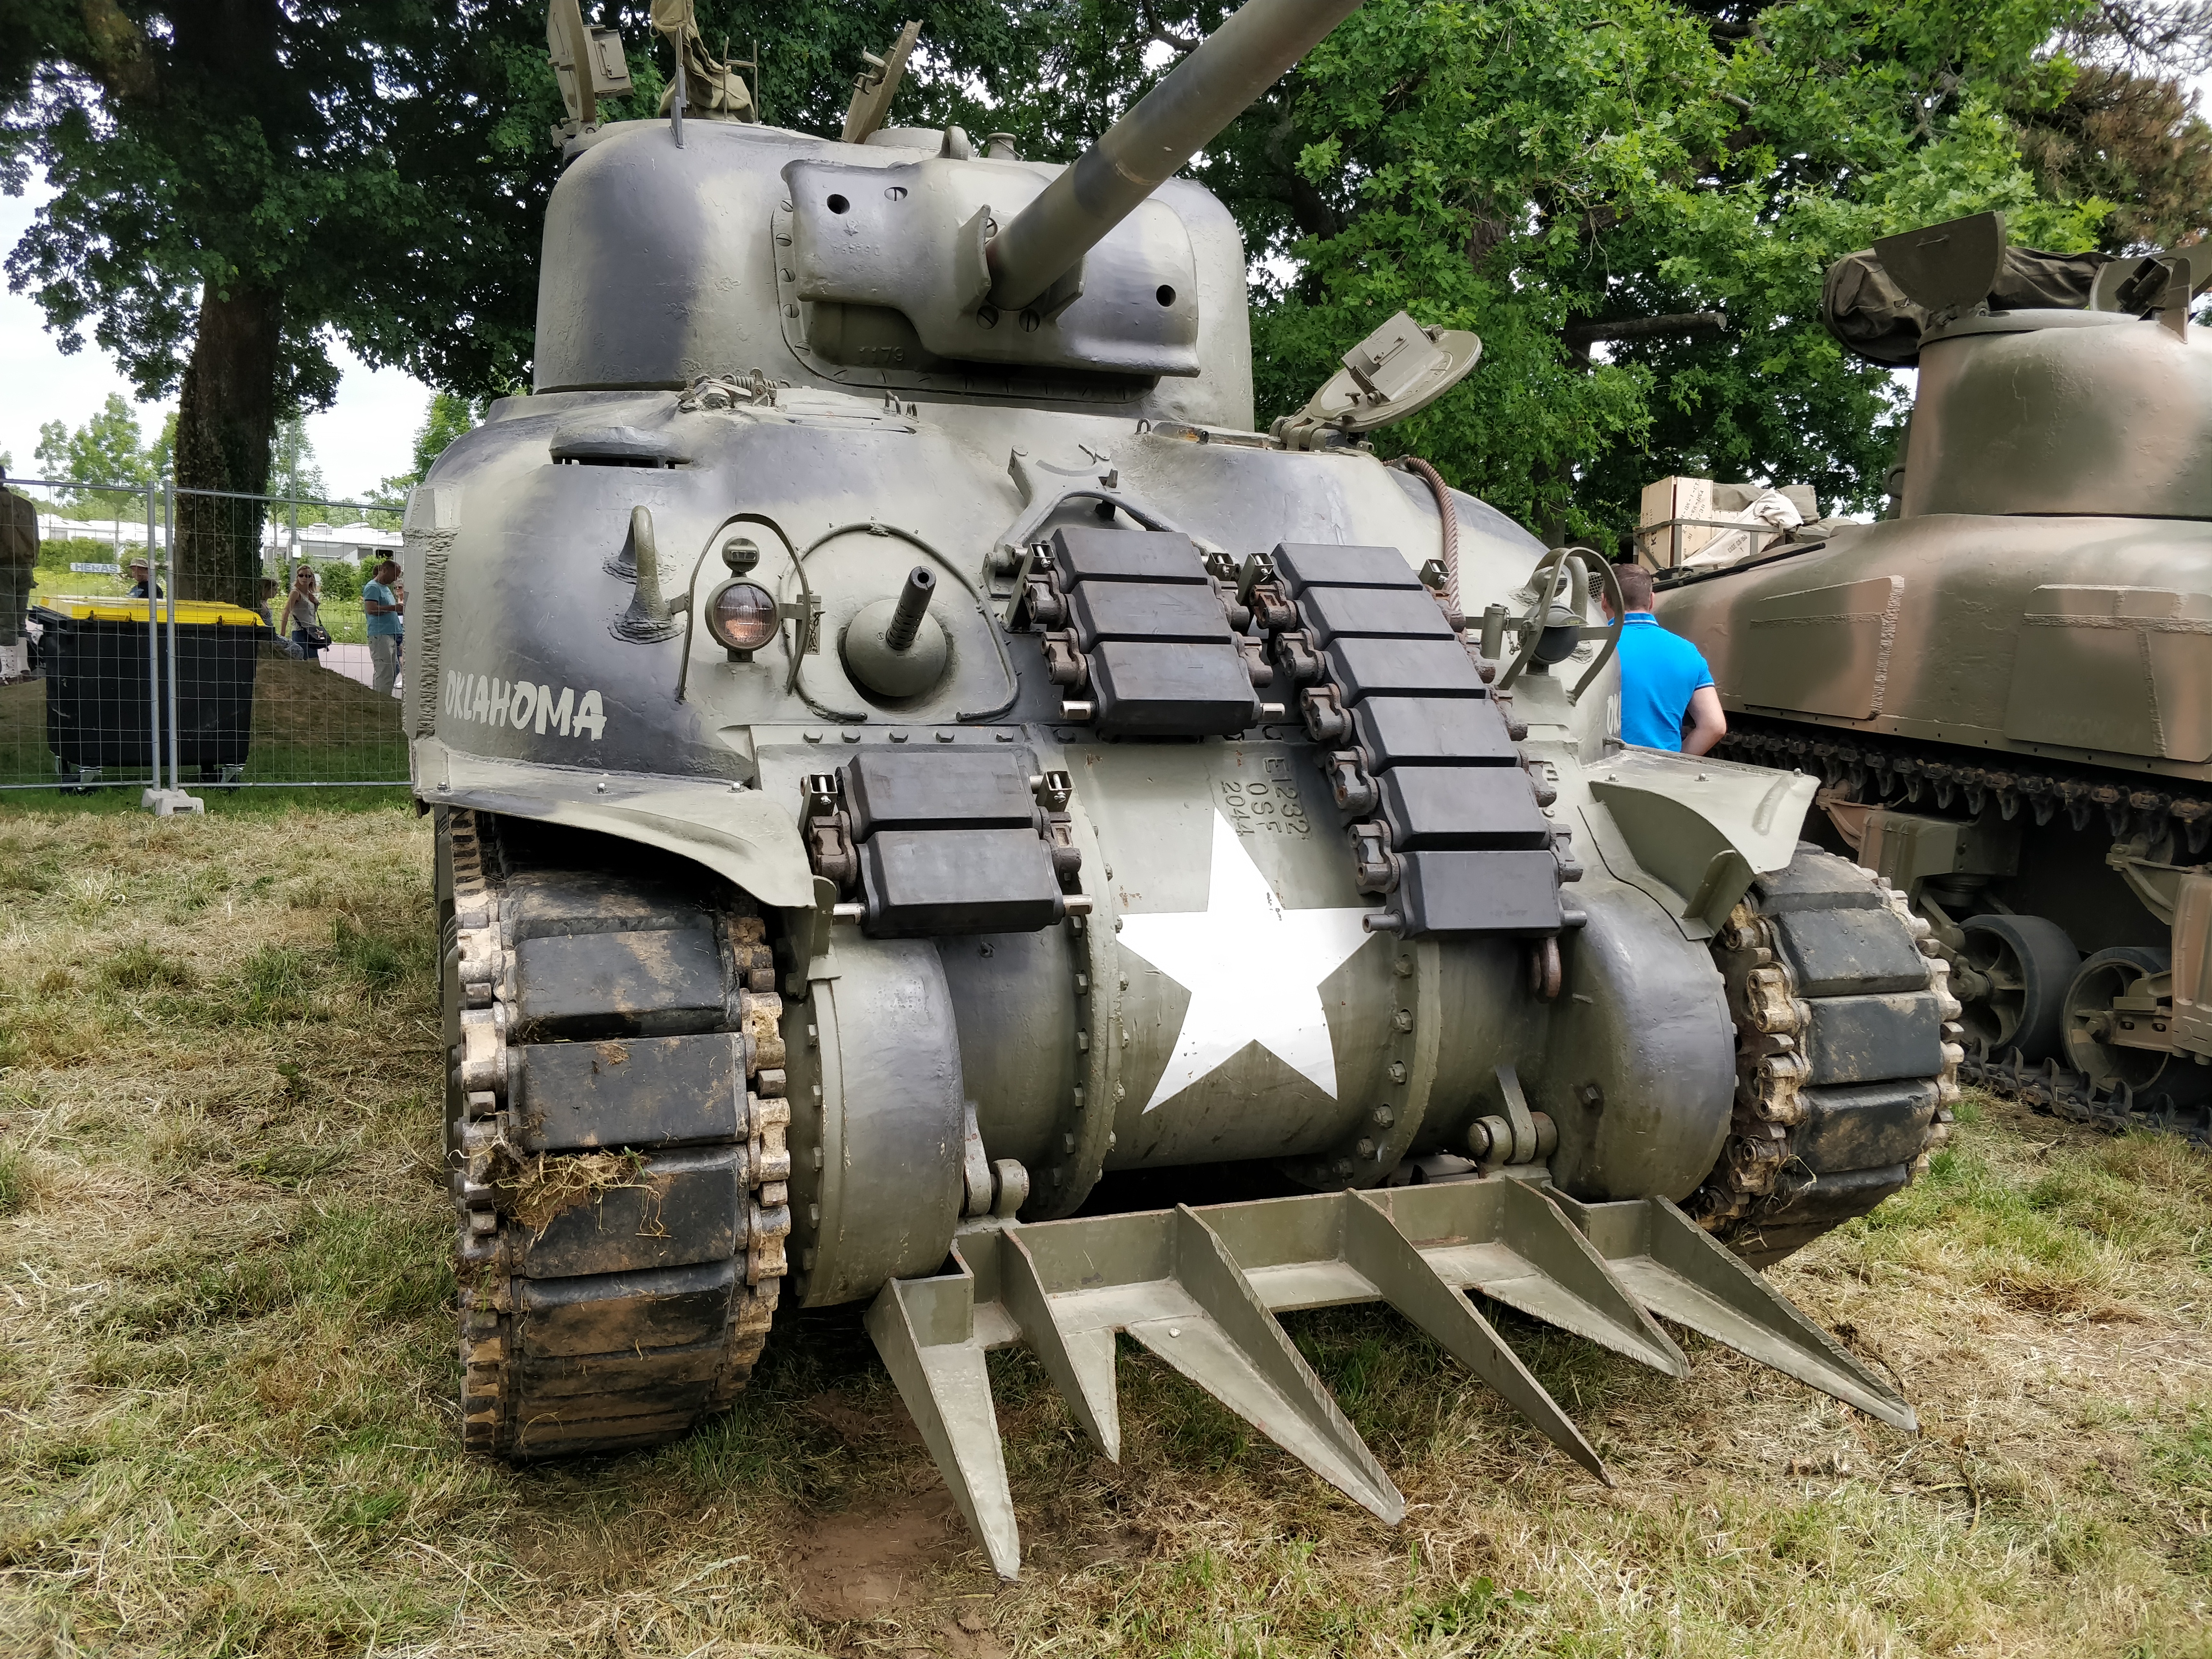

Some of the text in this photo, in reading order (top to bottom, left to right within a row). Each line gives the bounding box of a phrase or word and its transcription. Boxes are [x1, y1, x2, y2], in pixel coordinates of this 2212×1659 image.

[75, 563, 118, 572] HERAS
[445, 670, 607, 741] OKLAHOMA
[1221, 781, 1255, 837] 2044
